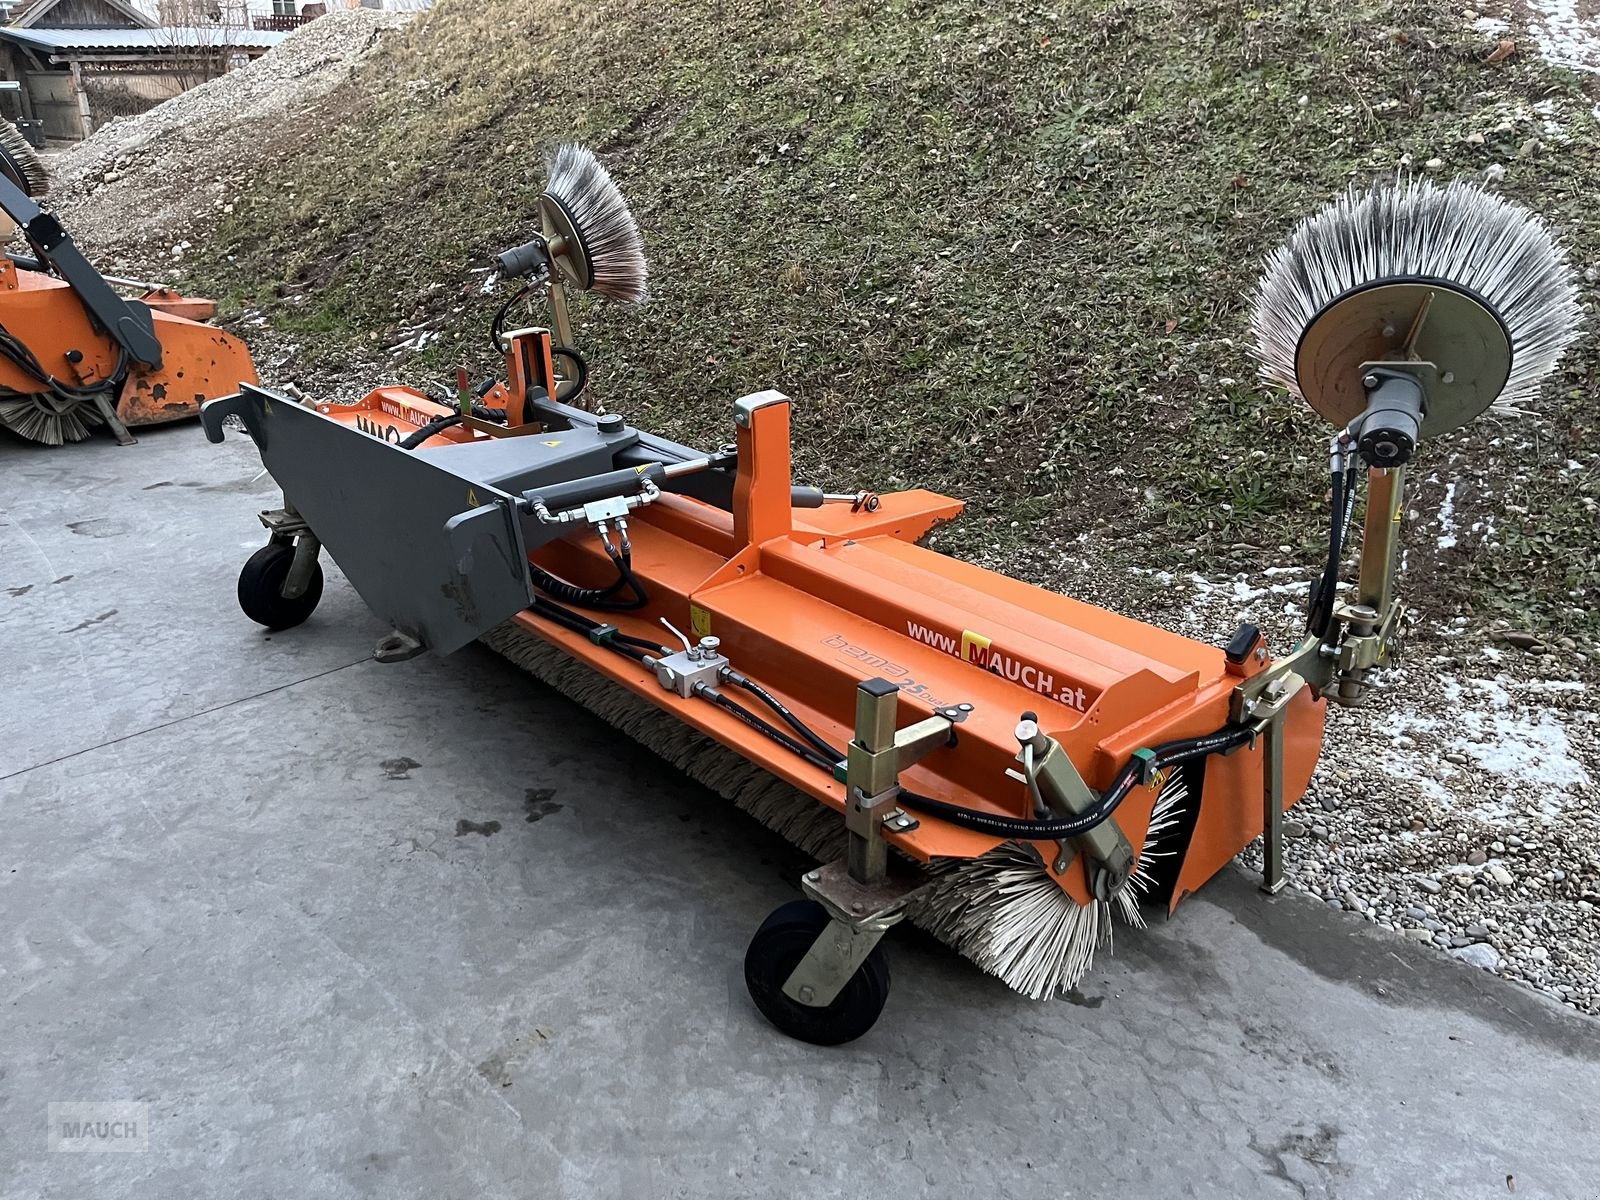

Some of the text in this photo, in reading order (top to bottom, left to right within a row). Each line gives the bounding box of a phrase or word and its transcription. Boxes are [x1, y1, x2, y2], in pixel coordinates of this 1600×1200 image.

[820, 634, 910, 677] bema
[896, 679, 929, 694] 25
[907, 621, 1086, 711] www.MAUCH.at
